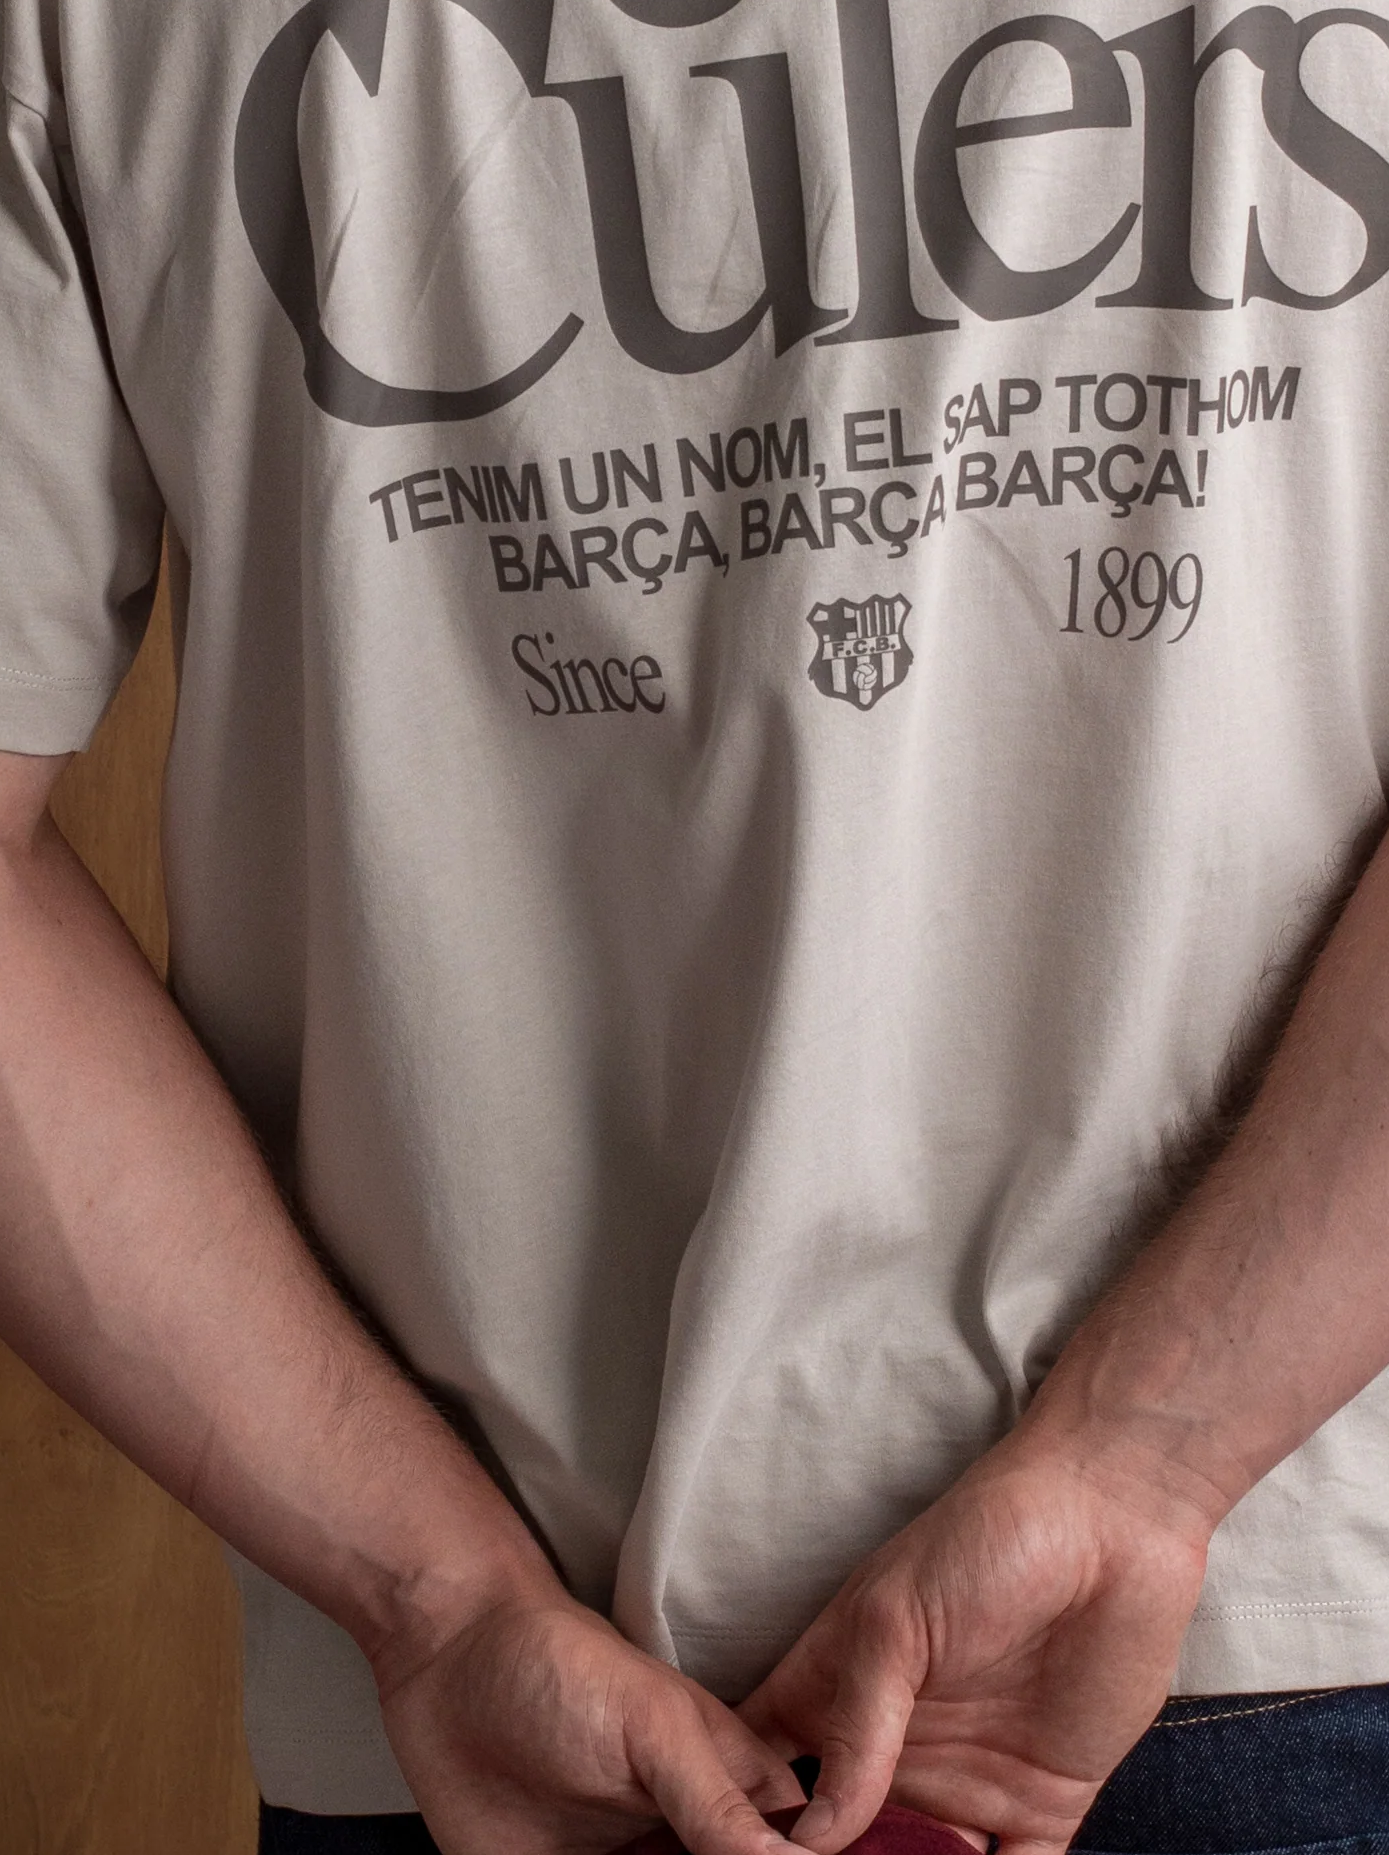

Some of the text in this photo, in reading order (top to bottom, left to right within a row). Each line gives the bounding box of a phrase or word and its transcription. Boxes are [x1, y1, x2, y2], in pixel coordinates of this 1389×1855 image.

[369, 366, 1302, 543] TENIM UN NOM, EL SAP TOTHOM
[488, 511, 730, 596] BARÇA,
[955, 444, 1209, 519] BARÇA!
[511, 546, 1204, 717] Since 1899
[831, 636, 897, 657] F.C.B.
